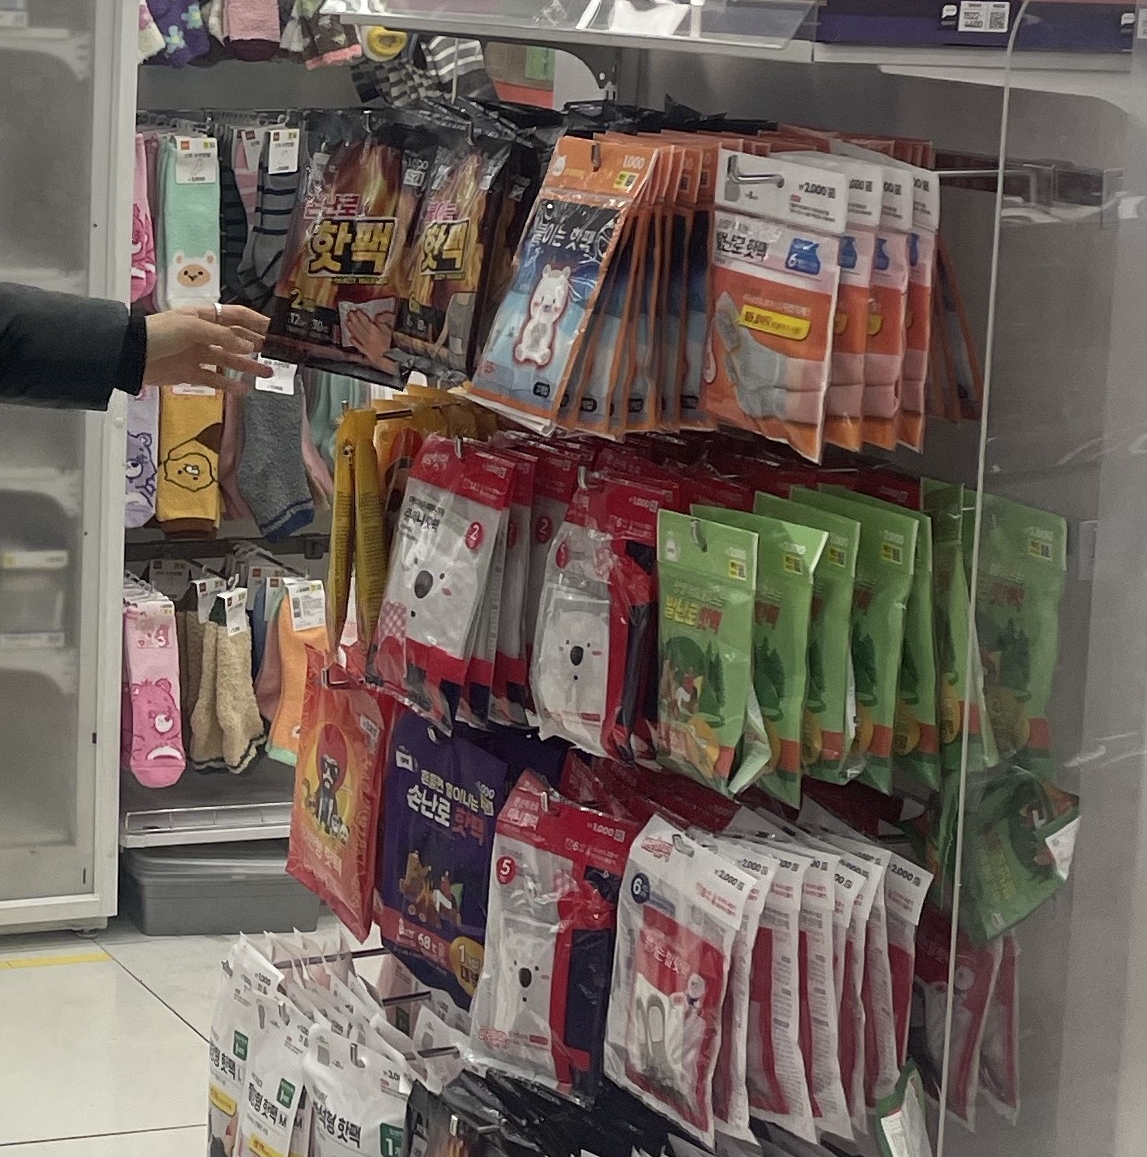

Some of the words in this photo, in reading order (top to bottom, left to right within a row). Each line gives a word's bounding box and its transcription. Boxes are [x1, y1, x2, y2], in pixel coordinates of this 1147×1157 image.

[309, 220, 395, 274] 핫팩
[421, 221, 469, 273] 핫팩
[406, 784, 451, 828] 손난로
[453, 807, 487, 846] 핫팩
[501, 859, 511, 876] 5
[632, 877, 643, 896] 6
[337, 1116, 362, 1149] 핫팩
